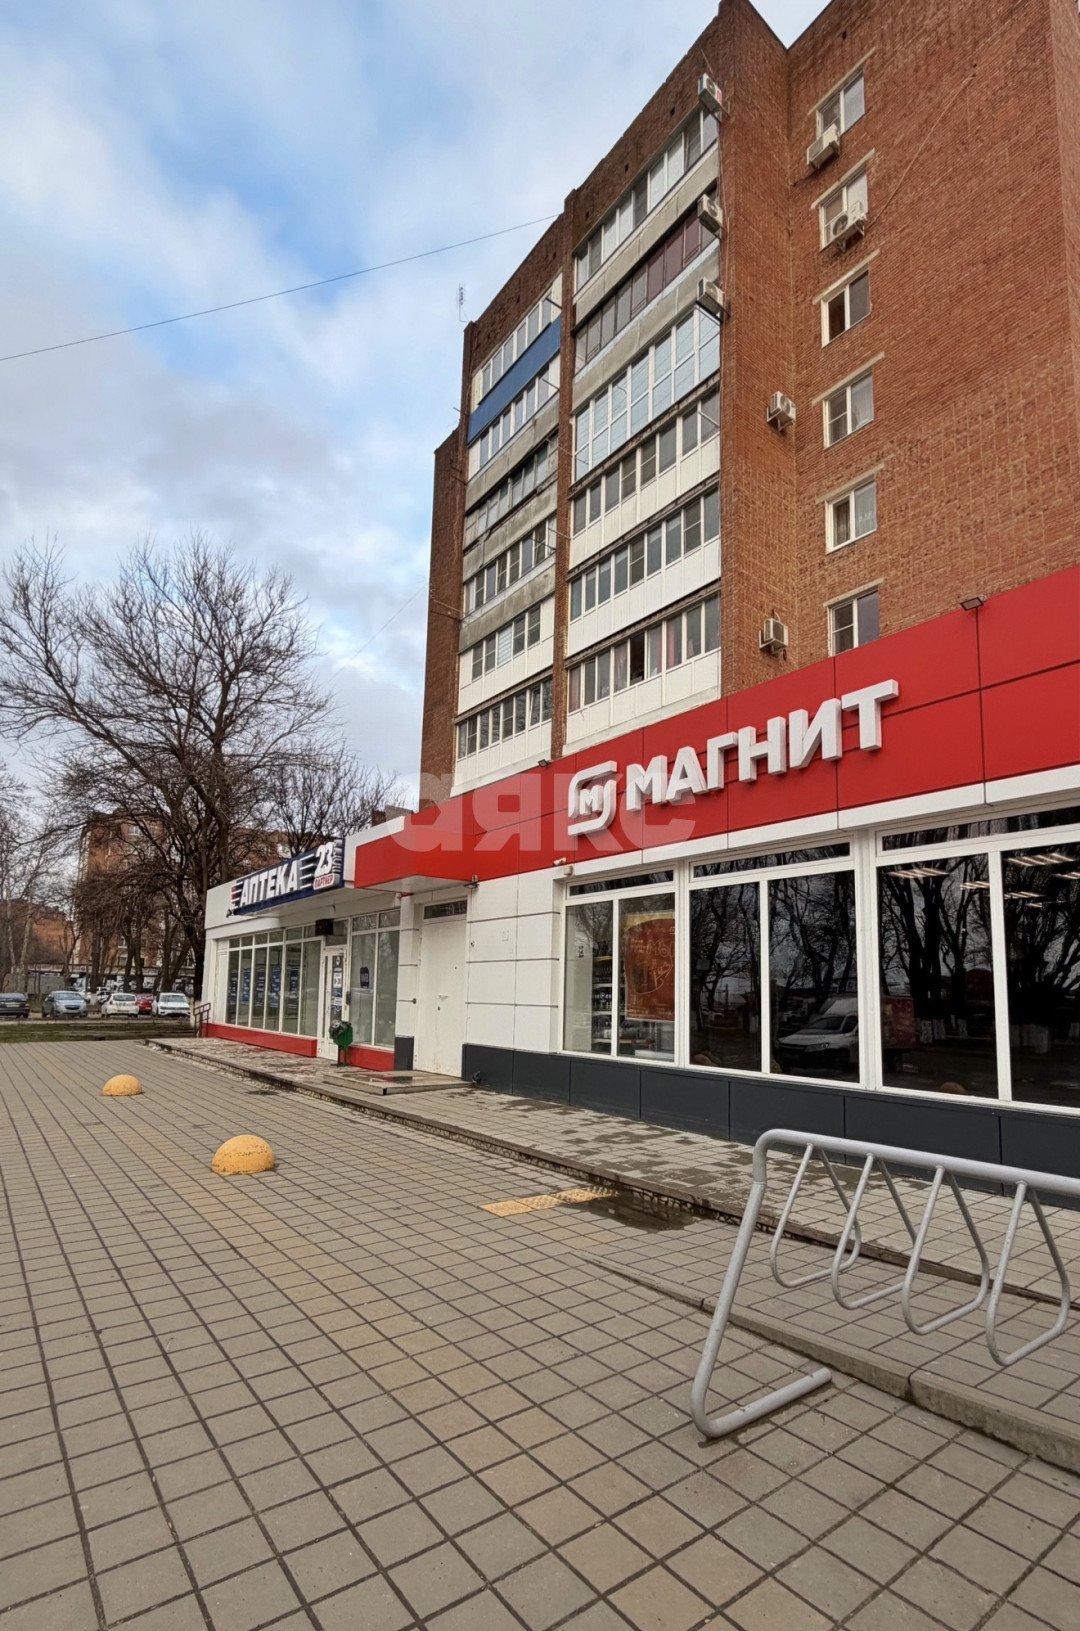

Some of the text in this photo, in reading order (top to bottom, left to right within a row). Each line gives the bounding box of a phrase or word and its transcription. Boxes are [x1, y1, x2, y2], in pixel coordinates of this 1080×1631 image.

[626, 679, 899, 811] МАГНИТ
[240, 859, 301, 908] АПТЕКА
[314, 841, 336, 878] 23
